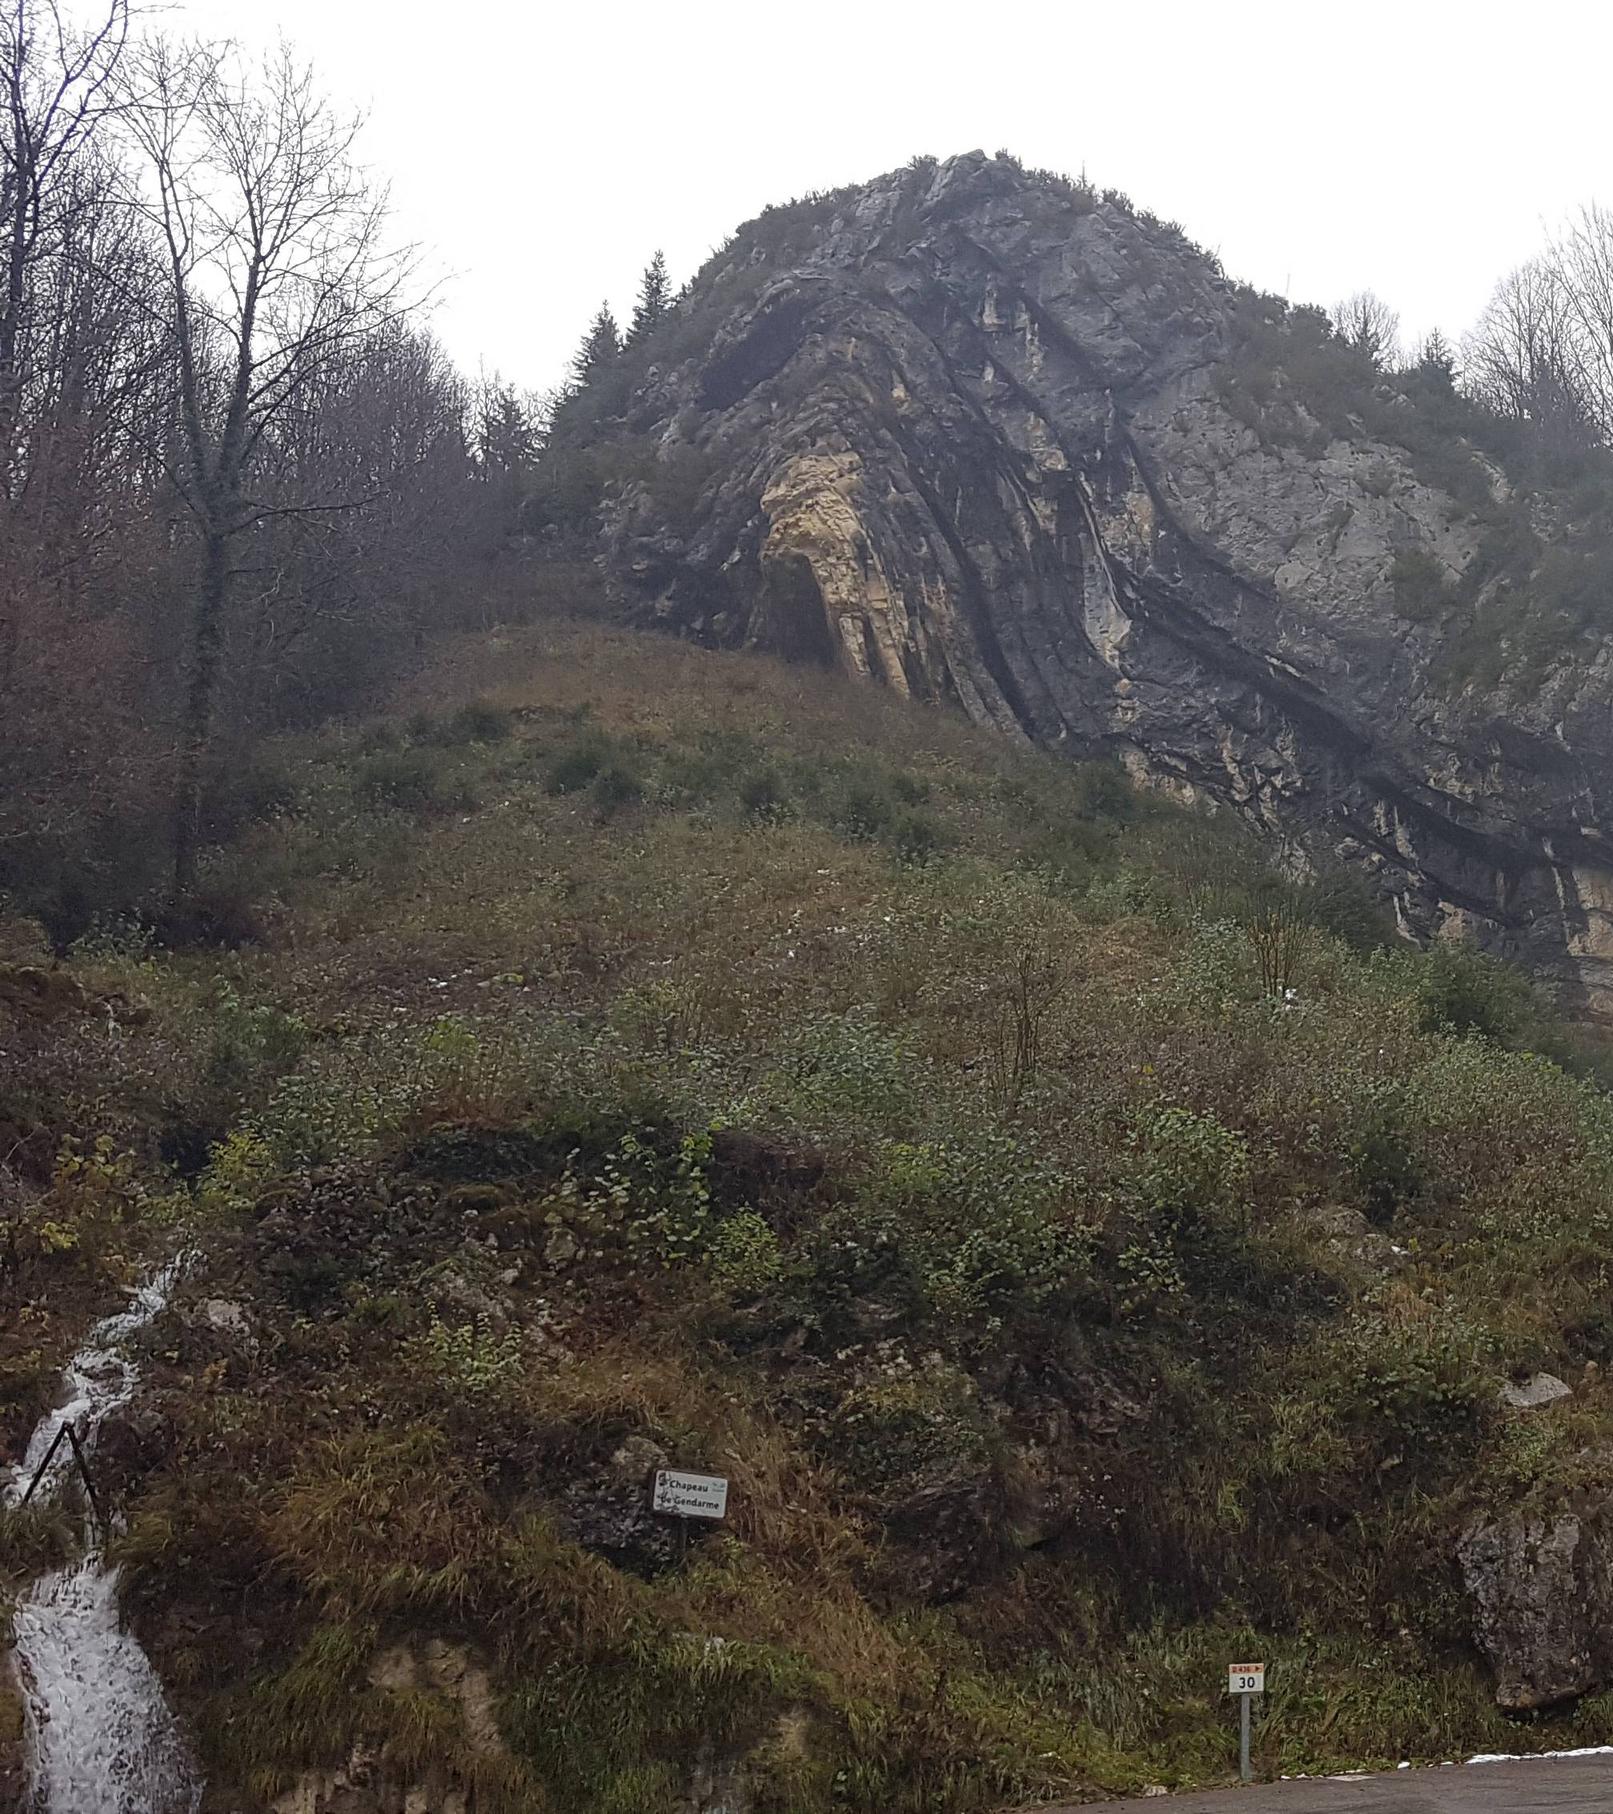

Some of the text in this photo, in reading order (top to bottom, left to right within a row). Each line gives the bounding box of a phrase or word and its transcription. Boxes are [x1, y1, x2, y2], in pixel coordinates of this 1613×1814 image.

[670, 1480, 708, 1492] Chapeau
[674, 1495, 719, 1509] Gendarme
[1239, 1677, 1255, 1688] 30
